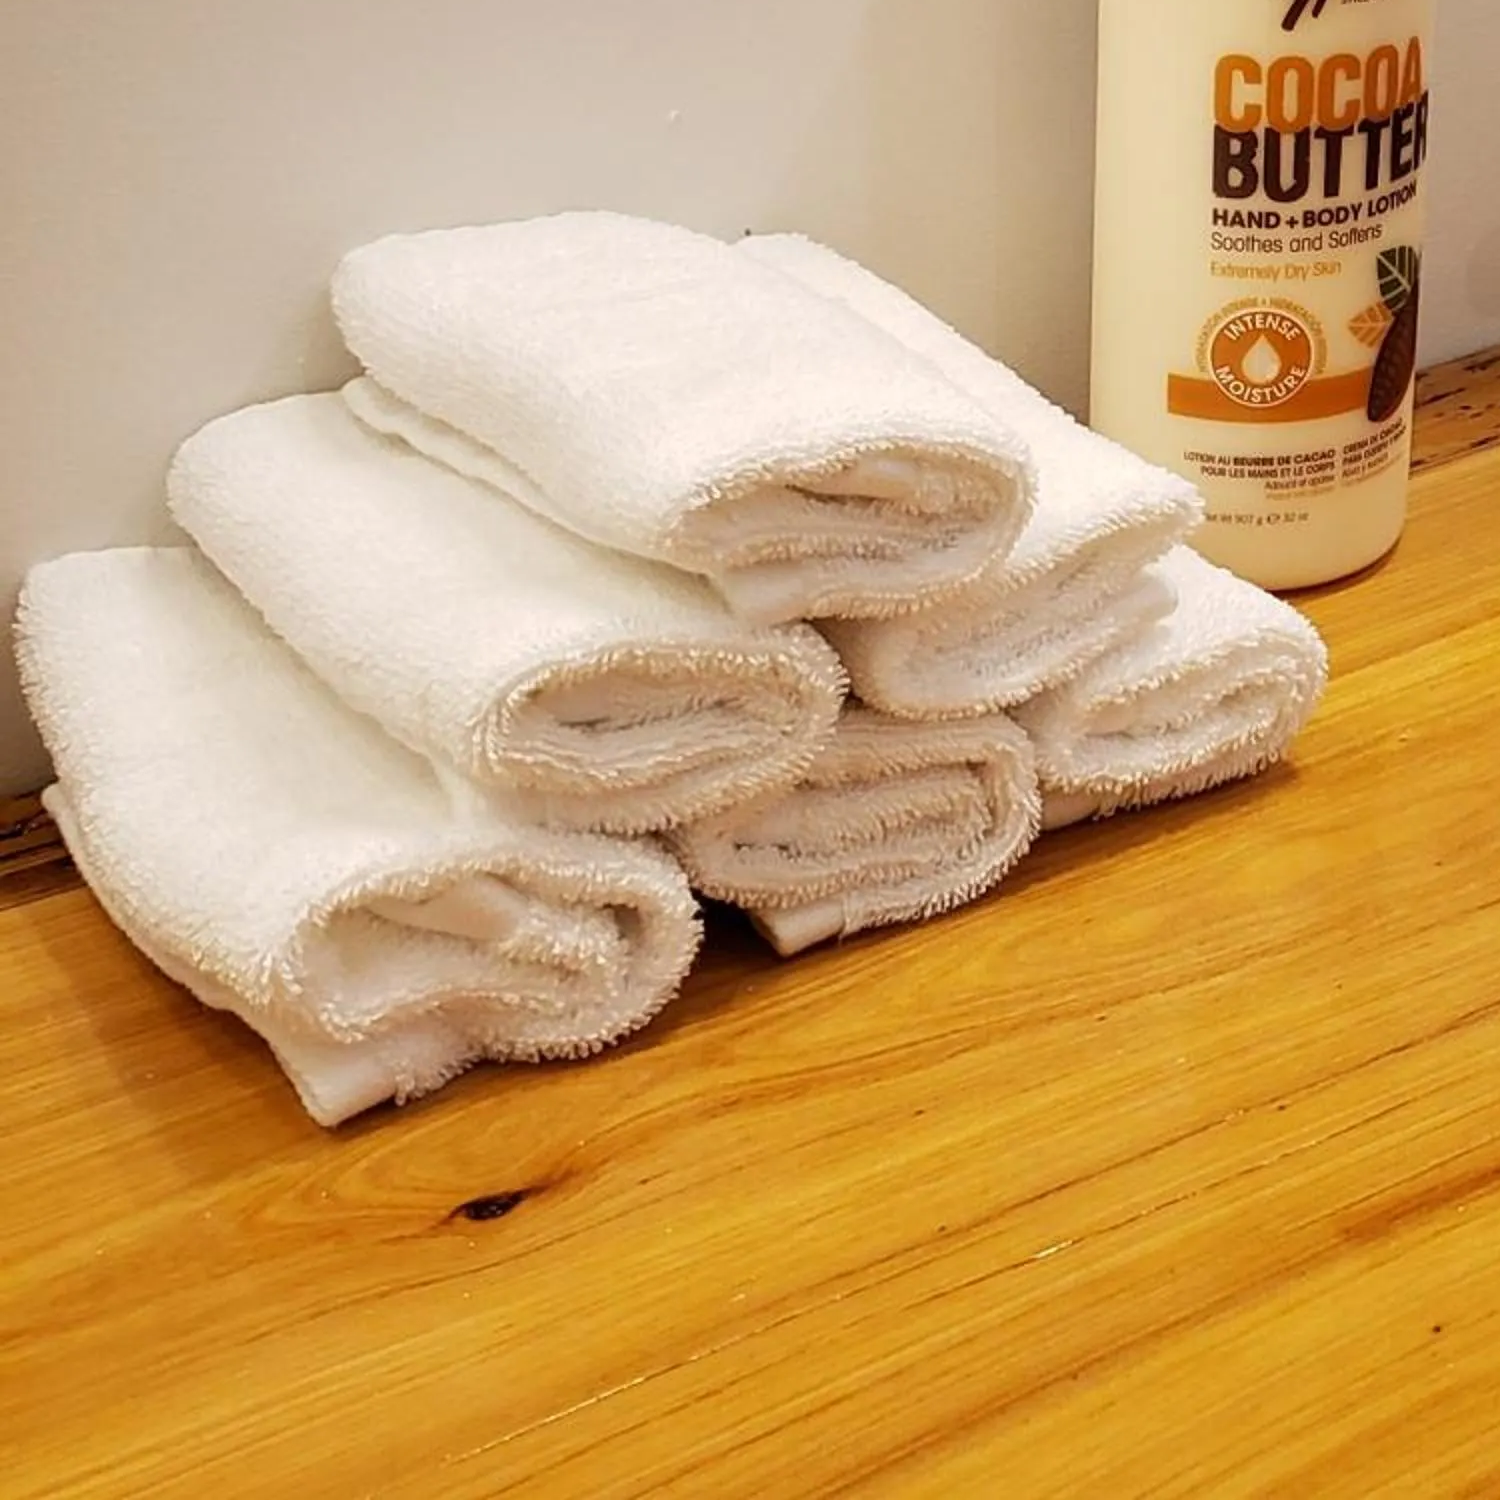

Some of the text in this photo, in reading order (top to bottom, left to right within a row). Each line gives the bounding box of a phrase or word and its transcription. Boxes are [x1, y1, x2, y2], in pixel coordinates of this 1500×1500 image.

[1213, 35, 1422, 134] COCOA
[1212, 88, 1429, 203] BUTTER
[1212, 208, 1281, 229] HAND
[1303, 201, 1363, 228] BODY
[1367, 178, 1417, 217] LOTION
[1211, 224, 1383, 253] Soothes and Softens
[1210, 260, 1342, 282] Extremely Dry Skin
[1223, 313, 1301, 341] INTENSE
[1215, 364, 1307, 403] MOISTURE
[1294, 449, 1336, 465] CACAO
